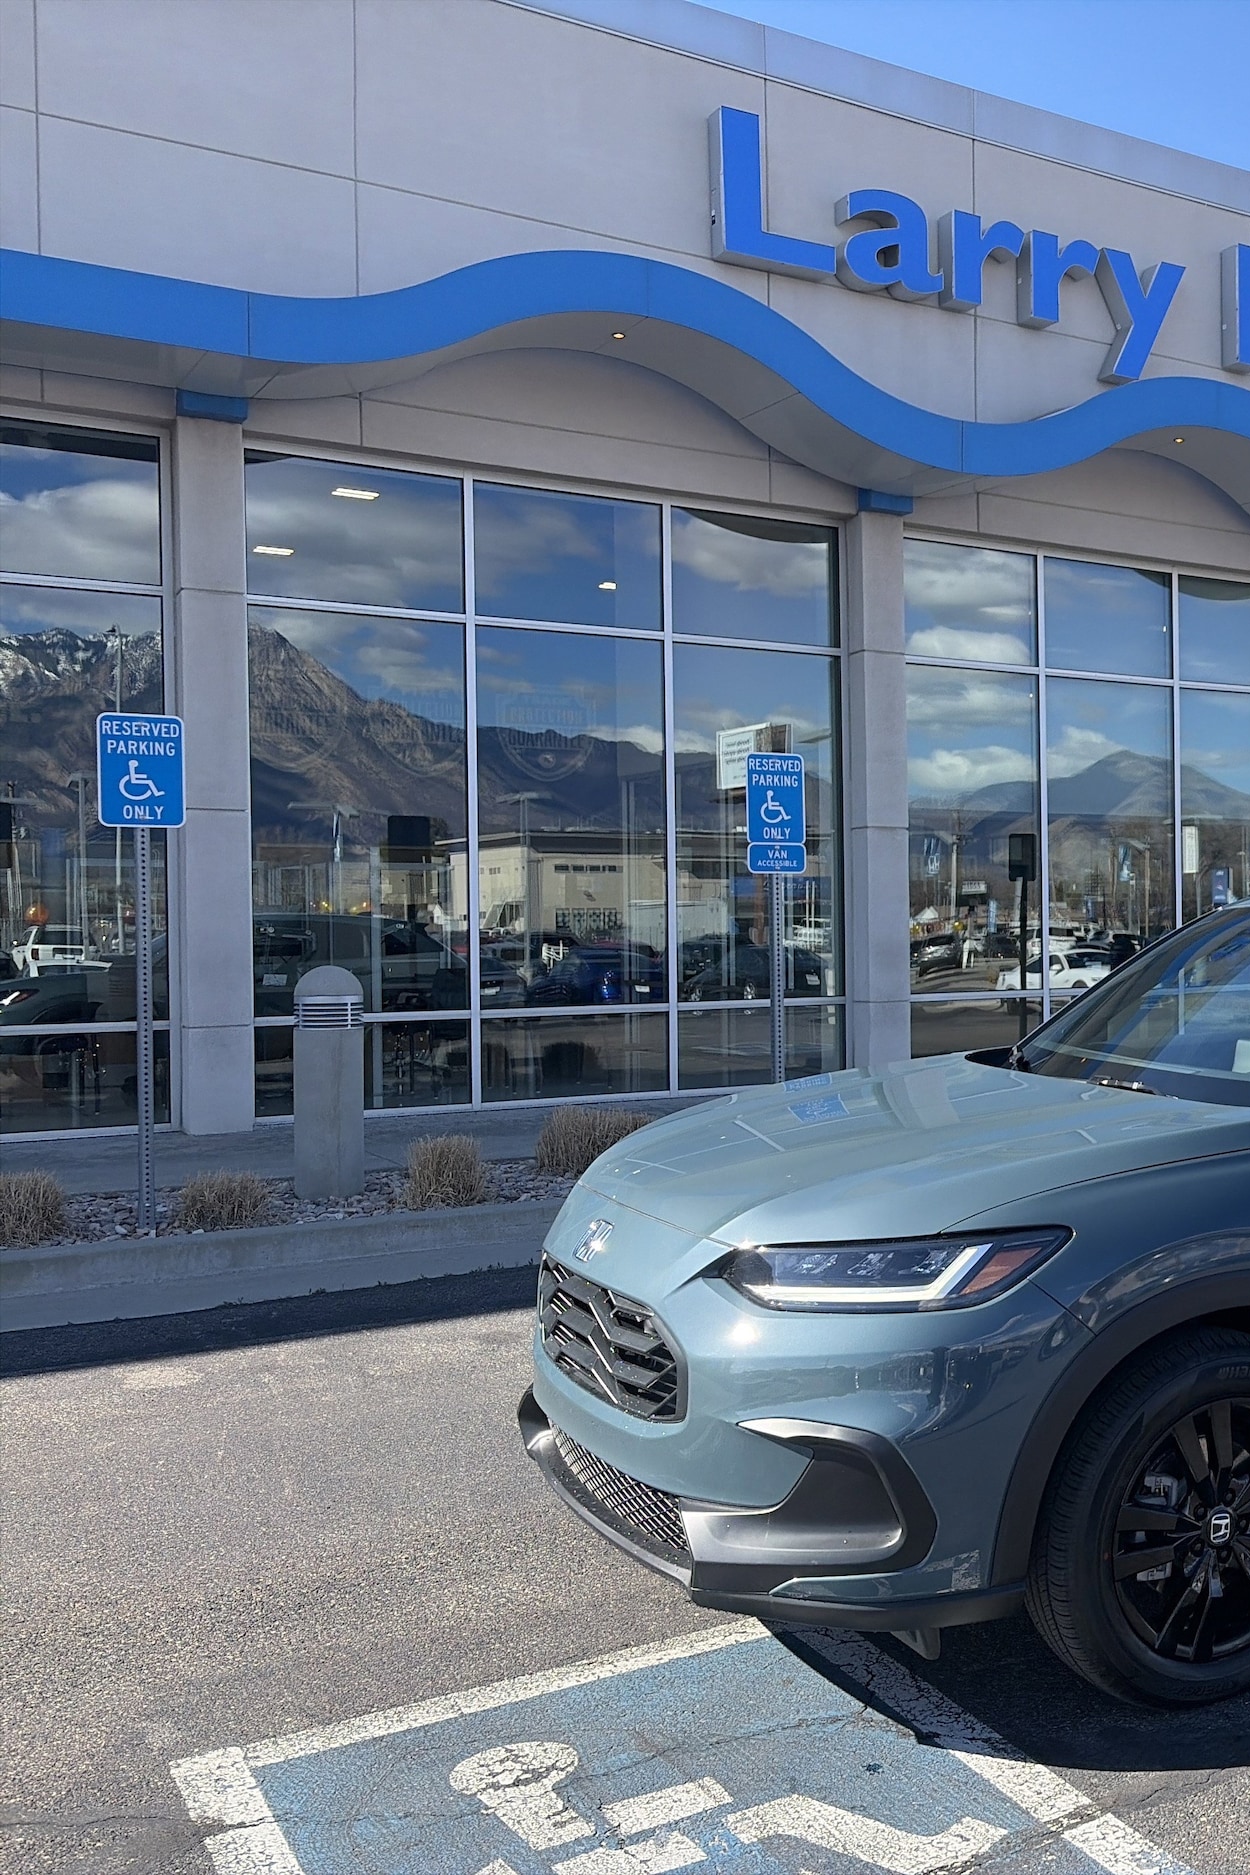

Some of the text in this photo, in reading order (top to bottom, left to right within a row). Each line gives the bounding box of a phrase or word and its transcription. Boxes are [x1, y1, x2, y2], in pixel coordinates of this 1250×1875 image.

[710, 105, 1186, 383] Larry
[102, 720, 180, 738] RESERVED
[107, 740, 176, 757] PARKING
[749, 758, 801, 773] RESERVED
[752, 774, 798, 788] PARKING
[123, 805, 164, 820] ONLY
[763, 827, 791, 840] ONLY
[768, 849, 788, 860] VAN
[757, 860, 798, 868] ACCESSIBLE
